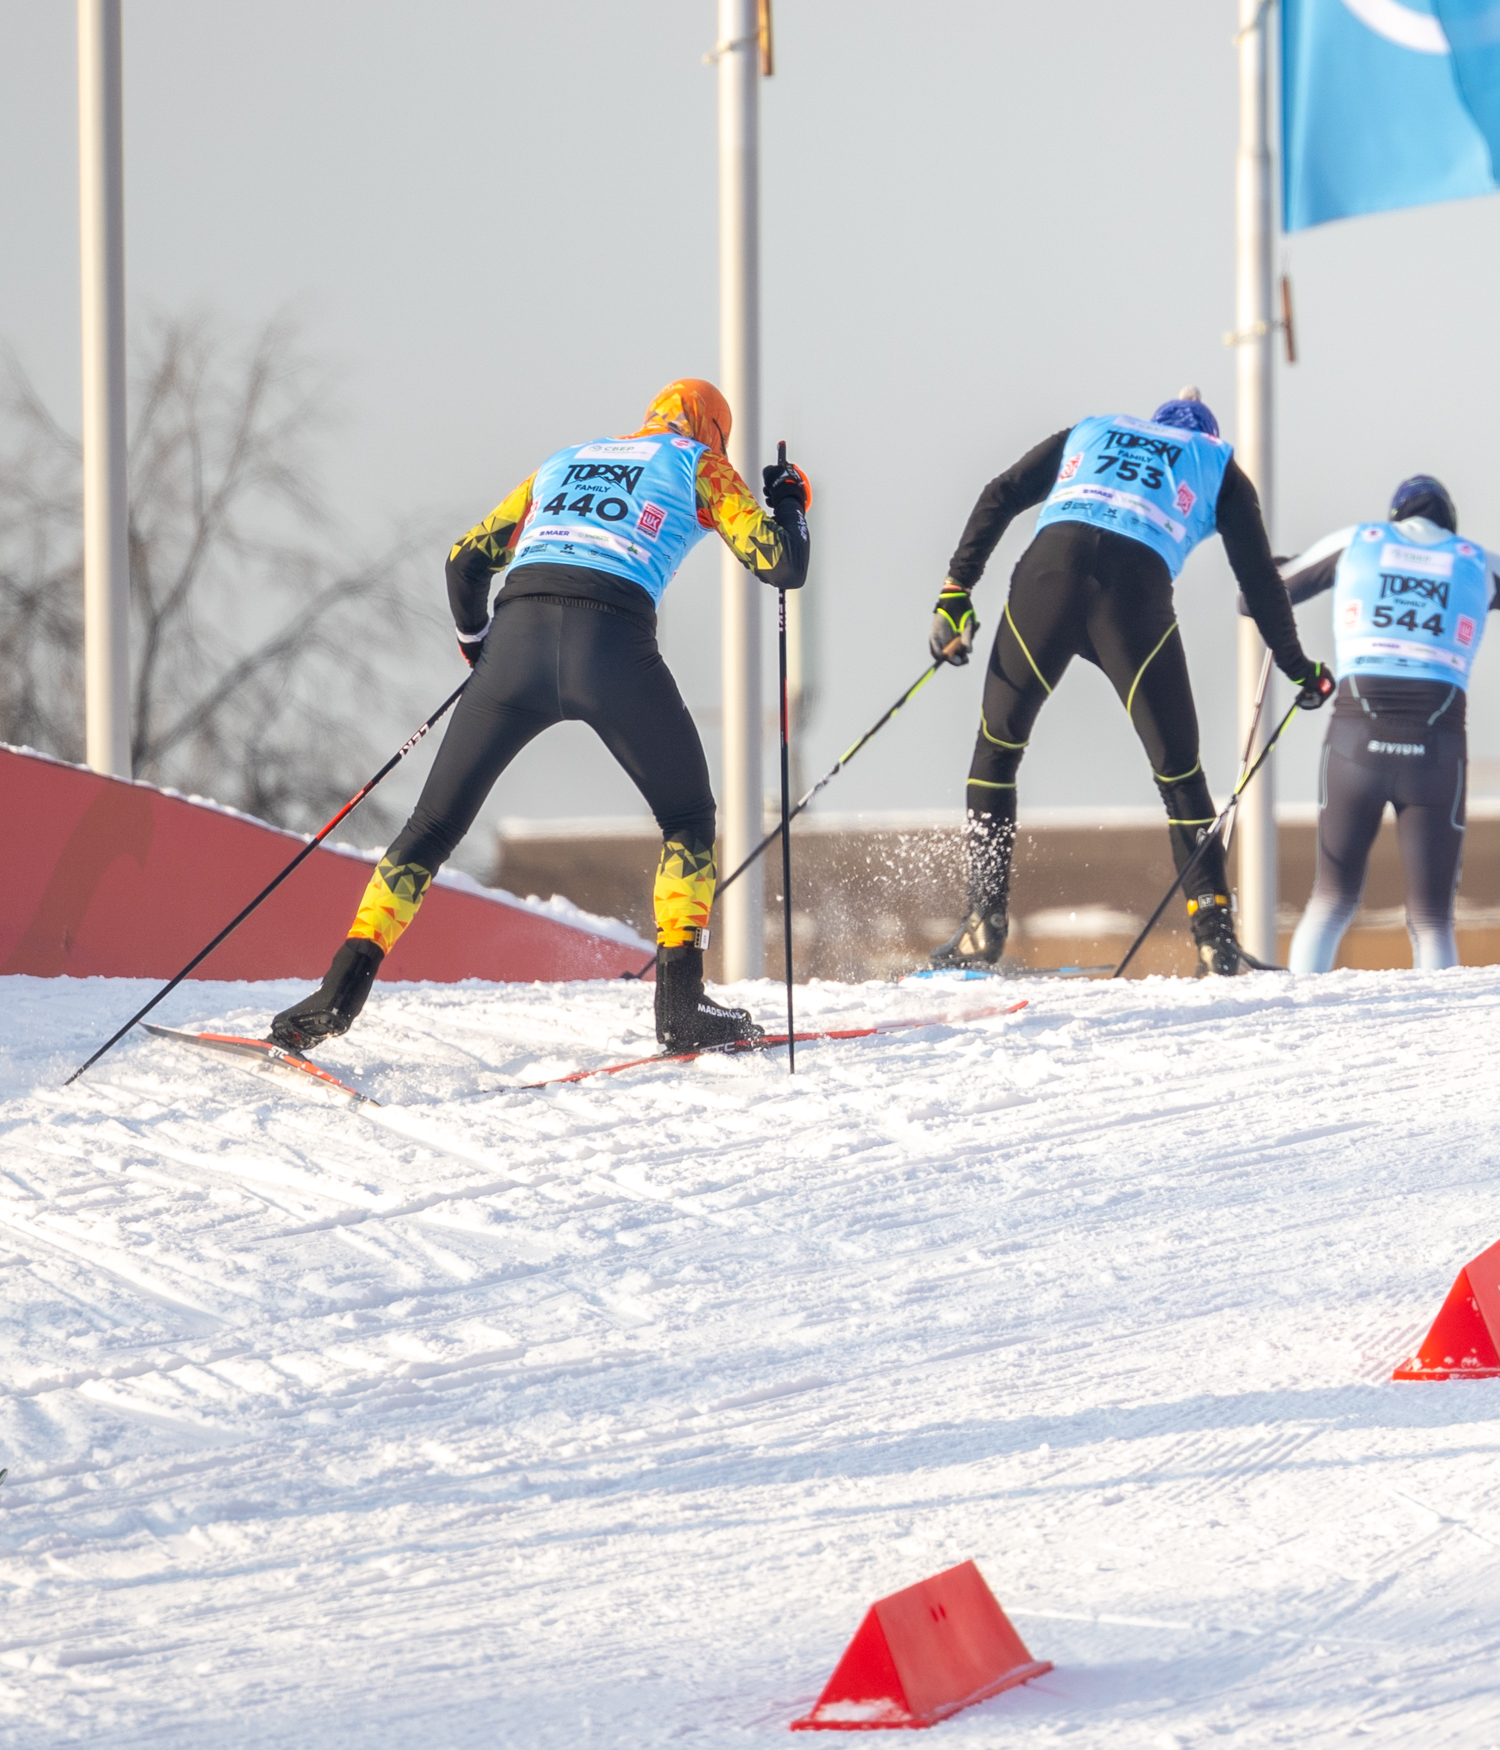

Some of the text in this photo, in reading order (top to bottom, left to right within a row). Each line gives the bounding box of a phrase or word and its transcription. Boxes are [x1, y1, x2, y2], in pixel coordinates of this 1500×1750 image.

[1104, 430, 1183, 467] TOPSKI
[1118, 449, 1154, 463] FAMILY
[561, 464, 645, 495] TOPSKI
[1094, 455, 1165, 489] 753
[574, 484, 611, 493] FAMILY
[543, 492, 629, 521] 440
[1379, 573, 1450, 609] TOPSKI
[1371, 605, 1445, 637] 544
